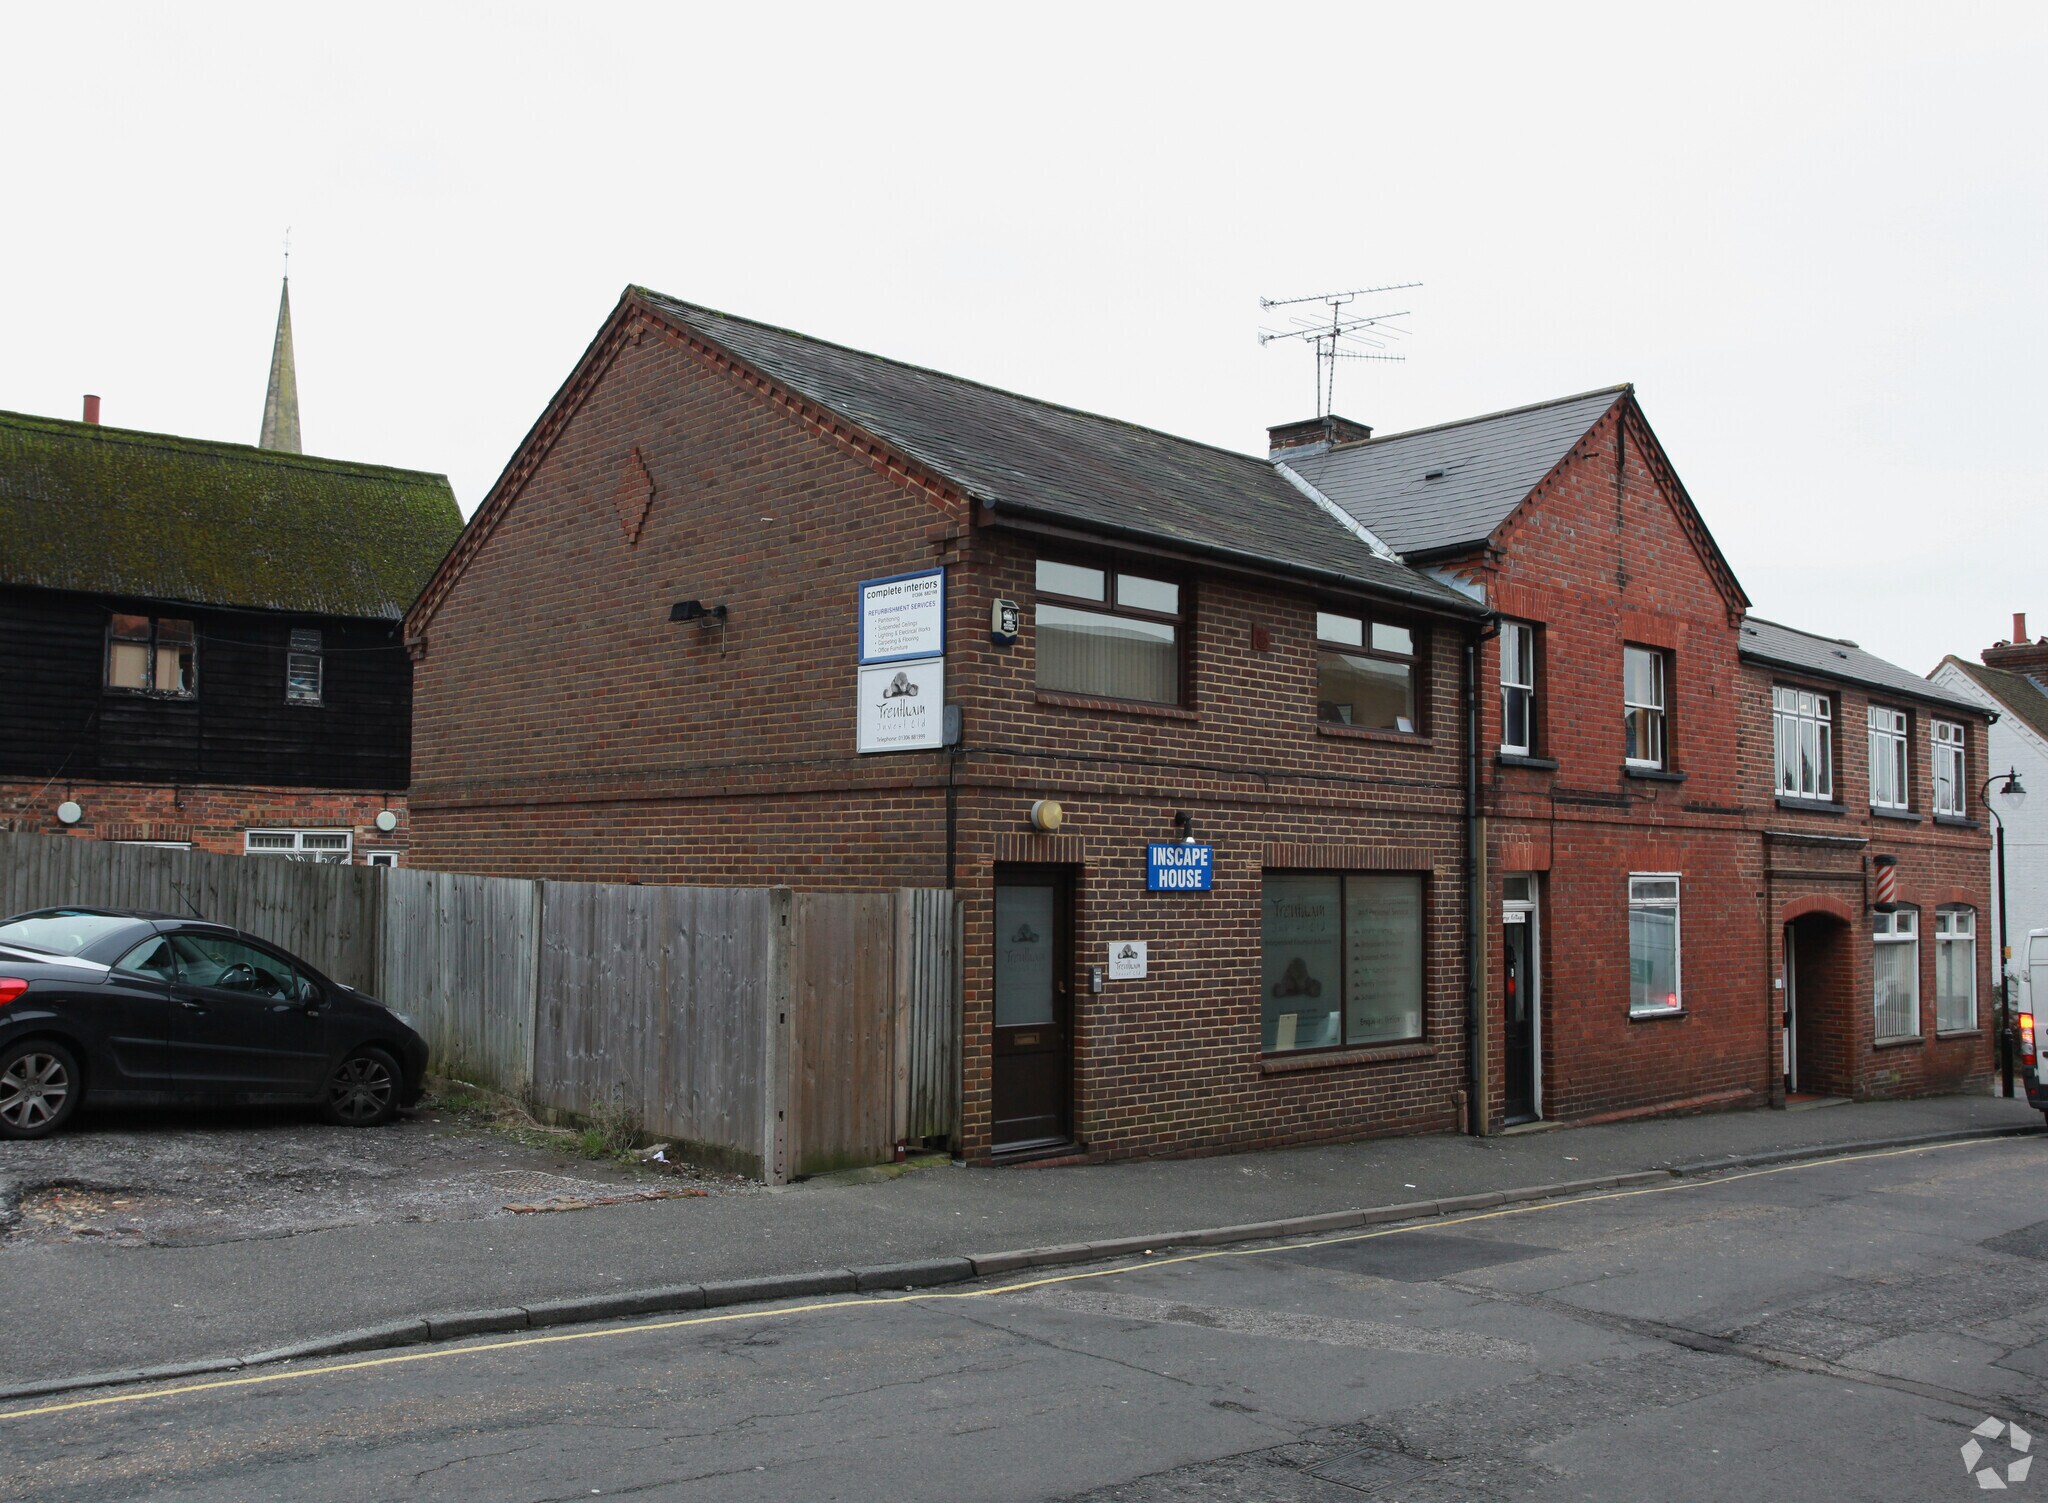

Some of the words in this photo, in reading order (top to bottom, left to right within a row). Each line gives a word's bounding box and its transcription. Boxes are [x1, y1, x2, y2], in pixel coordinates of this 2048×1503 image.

[866, 586, 902, 599] complete
[904, 580, 938, 593] interiors
[868, 604, 910, 617] REFURBISHMENT
[910, 600, 936, 611] SERVICES
[876, 698, 926, 719] Trentham
[1152, 847, 1208, 867] INSCAPE
[1158, 869, 1202, 888] HOUSE
